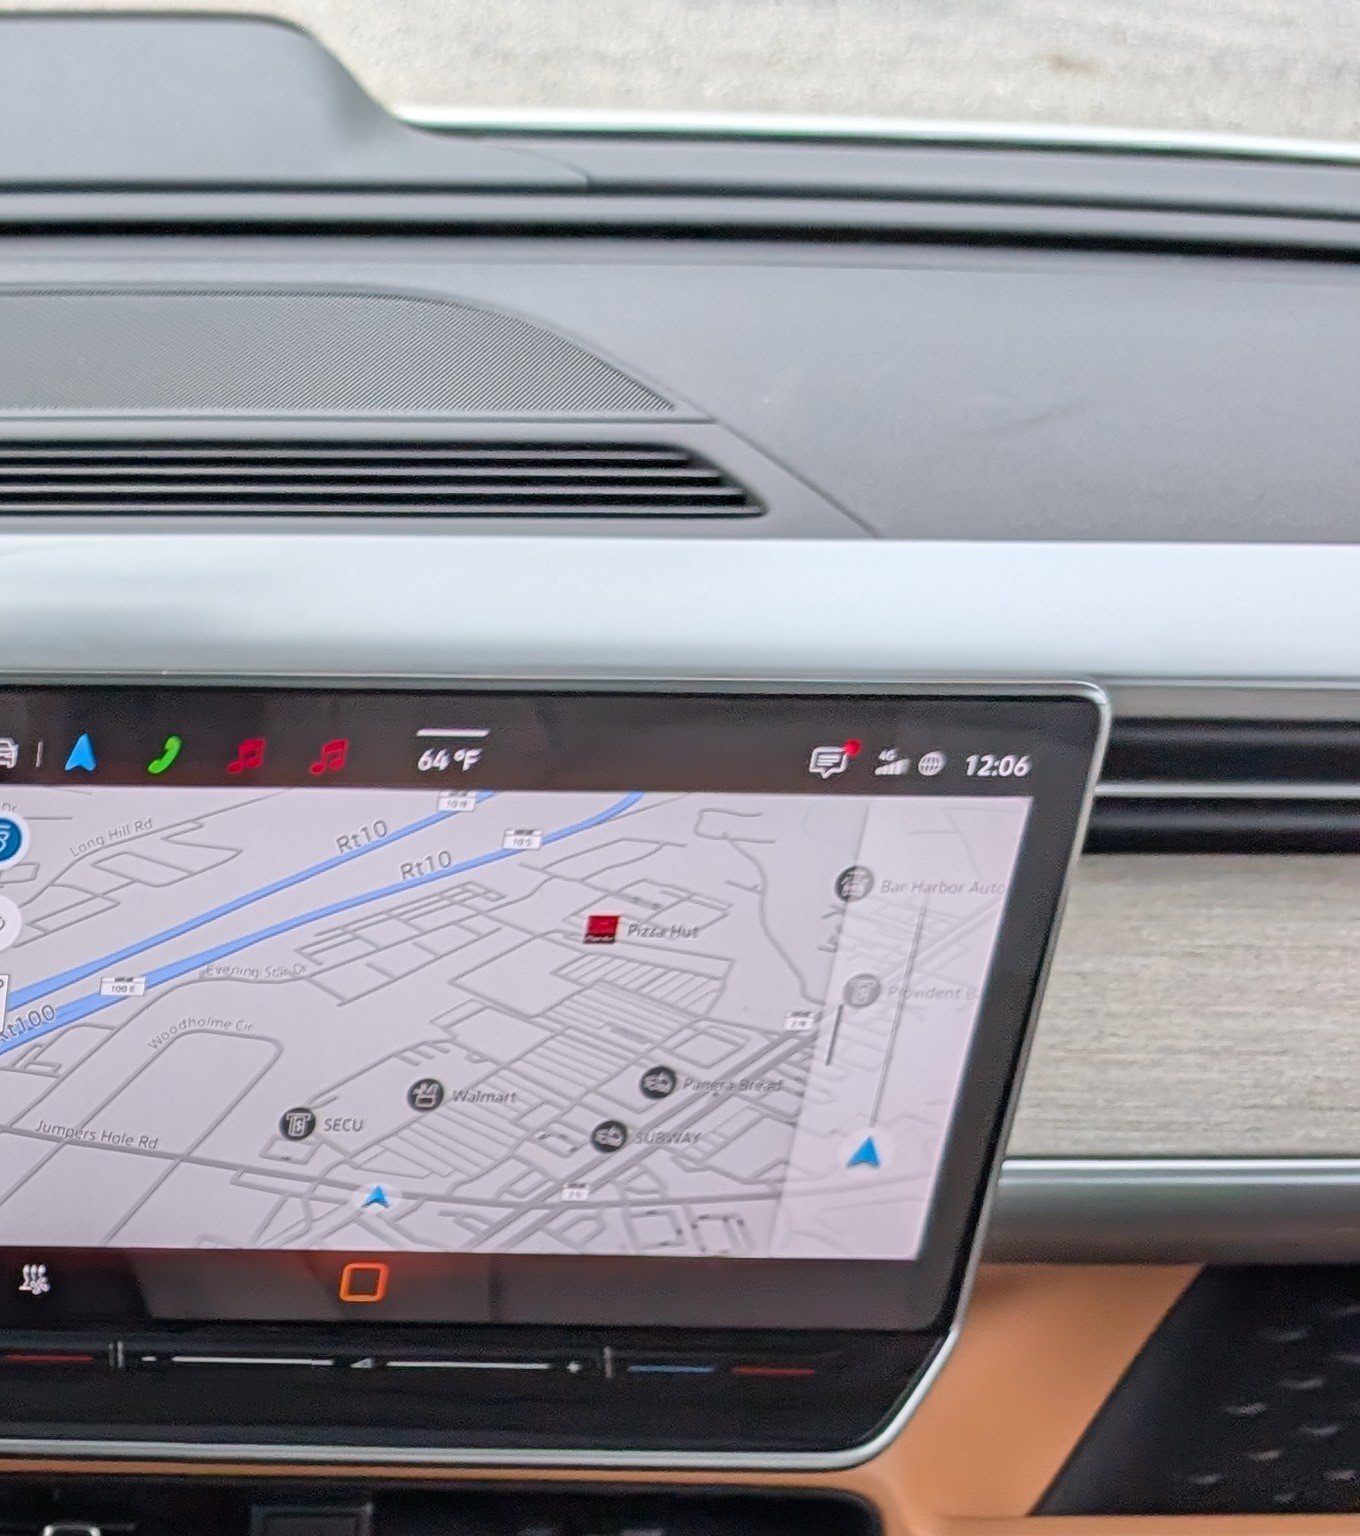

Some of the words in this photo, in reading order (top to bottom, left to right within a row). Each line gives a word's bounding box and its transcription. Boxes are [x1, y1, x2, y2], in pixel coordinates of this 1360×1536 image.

[417, 749, 451, 771] 64
[965, 754, 1030, 777] 12:06
[69, 836, 105, 857] Long
[109, 824, 131, 840] Hill
[134, 817, 153, 833] Rd
[336, 819, 388, 853] Rt10
[400, 850, 452, 881] Rt10
[881, 880, 905, 894] Bar
[911, 880, 963, 895] Harbor
[627, 924, 668, 939] Pizza
[670, 924, 699, 940] Hut
[206, 964, 260, 981] Evening
[147, 1016, 232, 1049] Woodholme
[452, 1089, 517, 1104] Walmart
[35, 1119, 97, 1142] Jumpers
[100, 1129, 136, 1147] Hole
[138, 1134, 160, 1150] Rd
[323, 1118, 364, 1132] SECU
